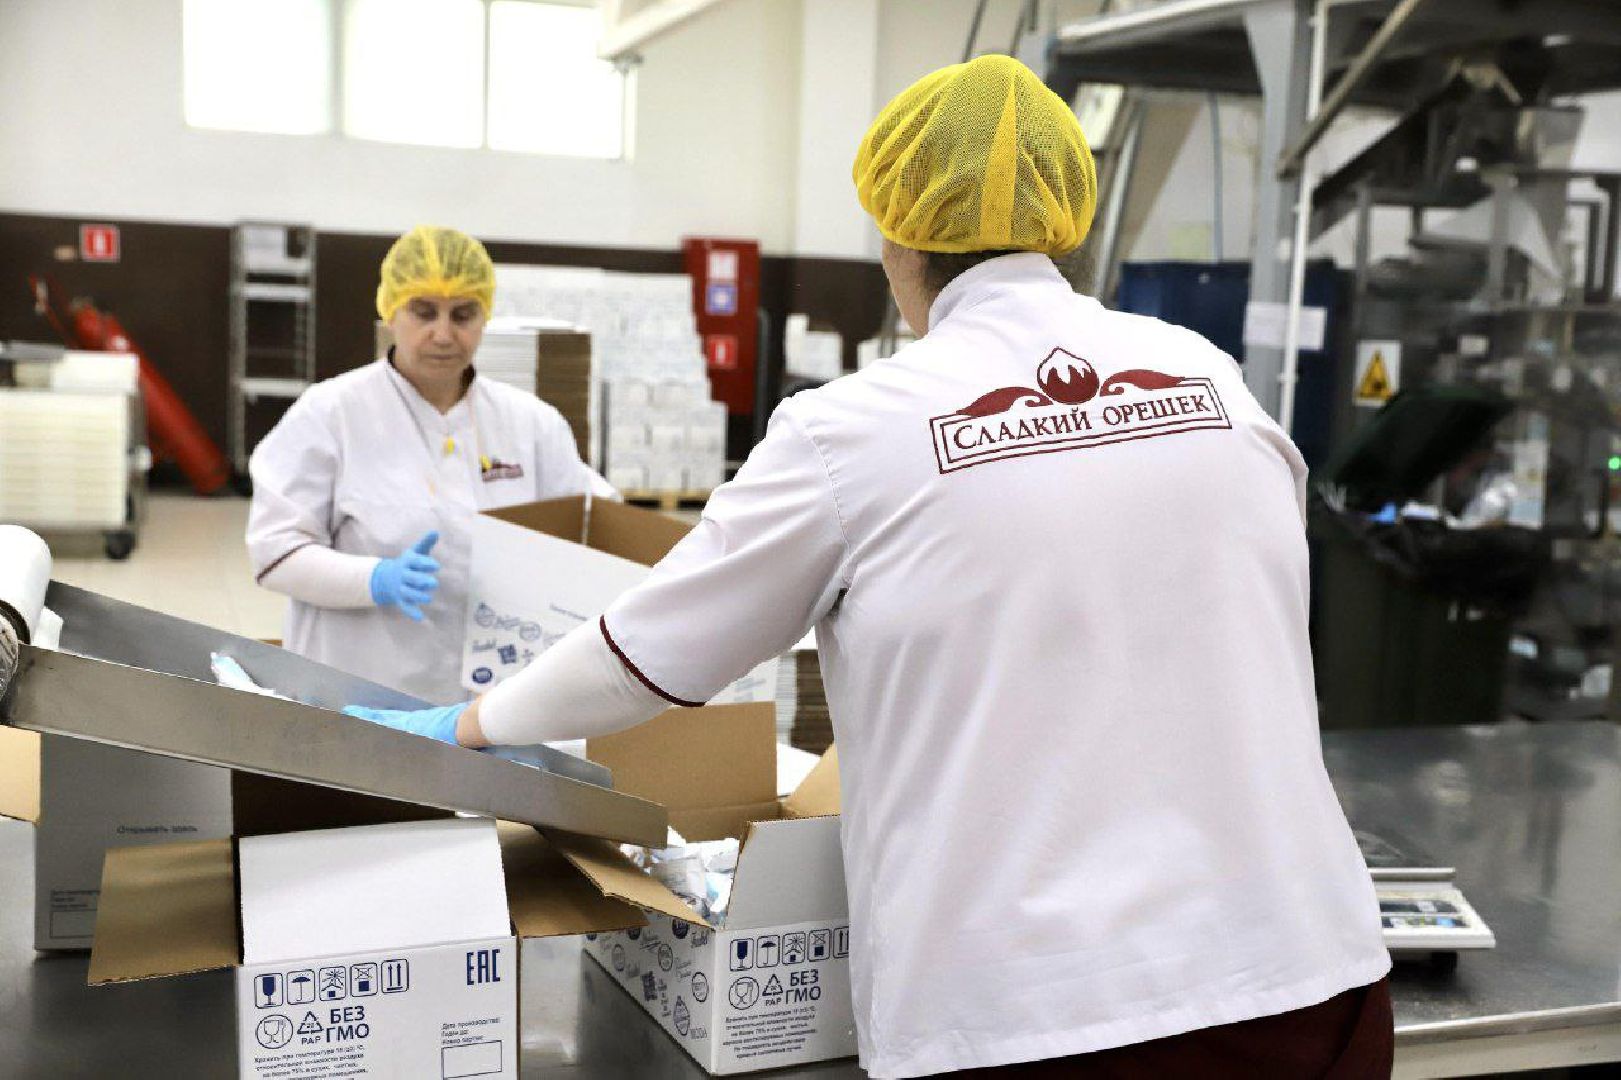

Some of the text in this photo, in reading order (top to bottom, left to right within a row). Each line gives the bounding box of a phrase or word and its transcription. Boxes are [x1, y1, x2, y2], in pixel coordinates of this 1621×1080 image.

[953, 394, 1211, 450] СЛАДКИЙ ОРЕШЕК
[790, 969, 818, 986] БЕЗ
[786, 986, 821, 1004] ГМО
[330, 1006, 365, 1024] БЕЗ
[301, 1036, 321, 1045] PAP
[327, 1023, 370, 1042] ГМО
